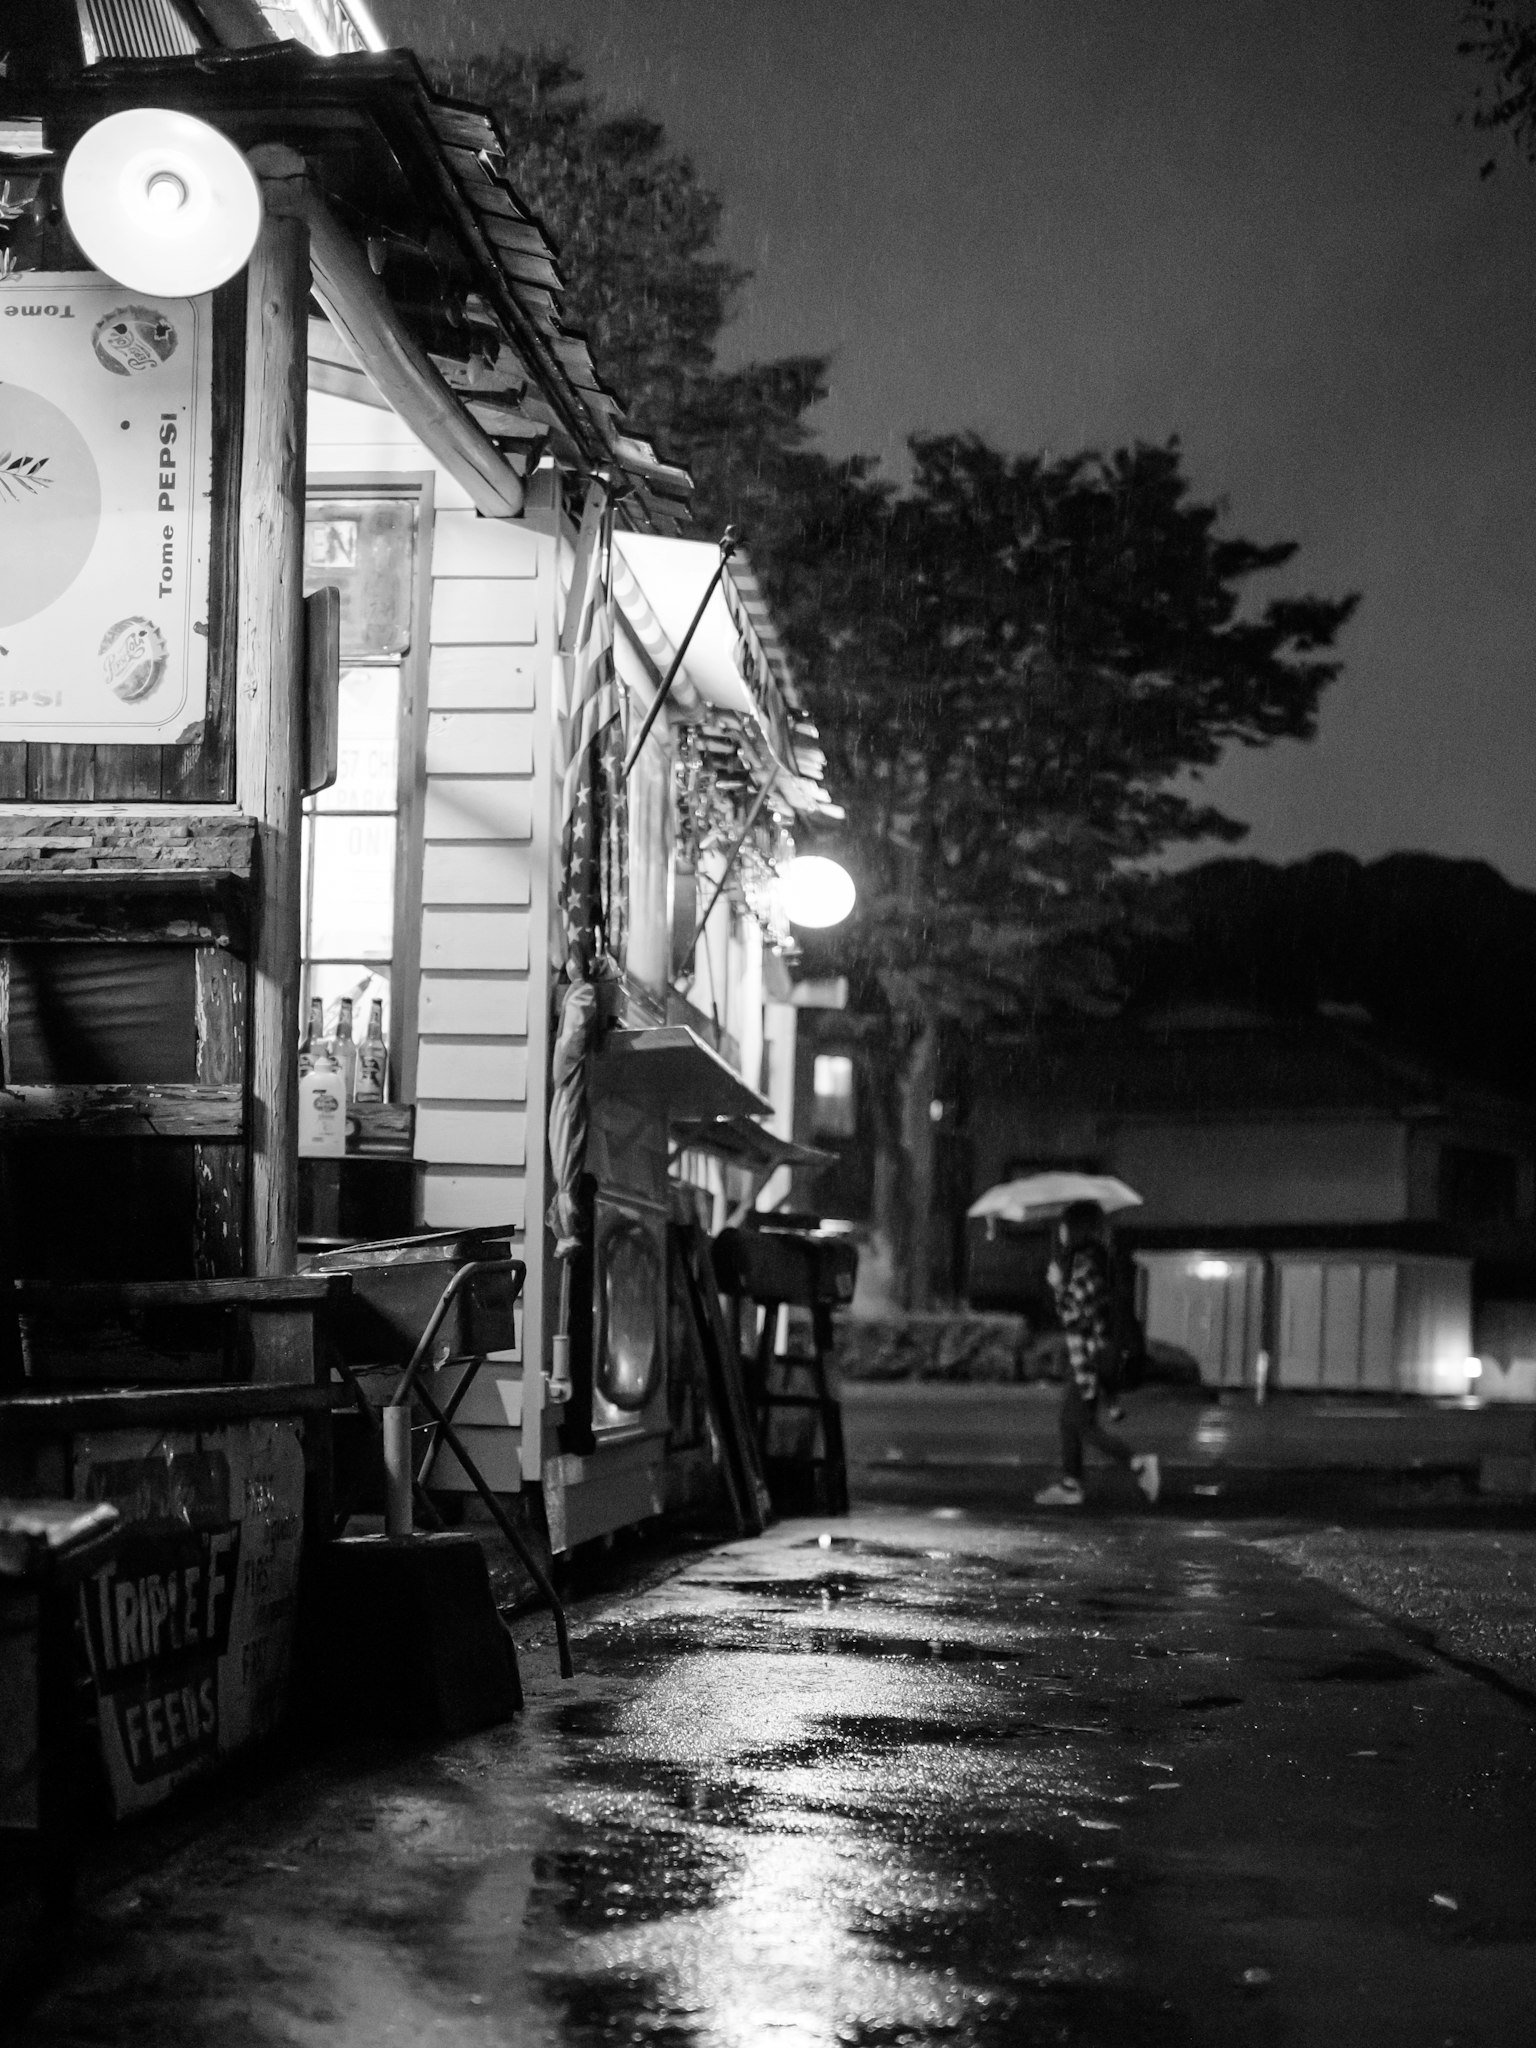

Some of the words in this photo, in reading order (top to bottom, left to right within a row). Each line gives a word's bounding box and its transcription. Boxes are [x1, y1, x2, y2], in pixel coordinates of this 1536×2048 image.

[4, 304, 76, 319] Tome
[158, 413, 178, 512] PEPSI
[158, 524, 175, 599] Tome
[0, 690, 63, 708] PSI
[90, 1560, 200, 1671] TRIPLE
[125, 1677, 215, 1769] FEEDS
